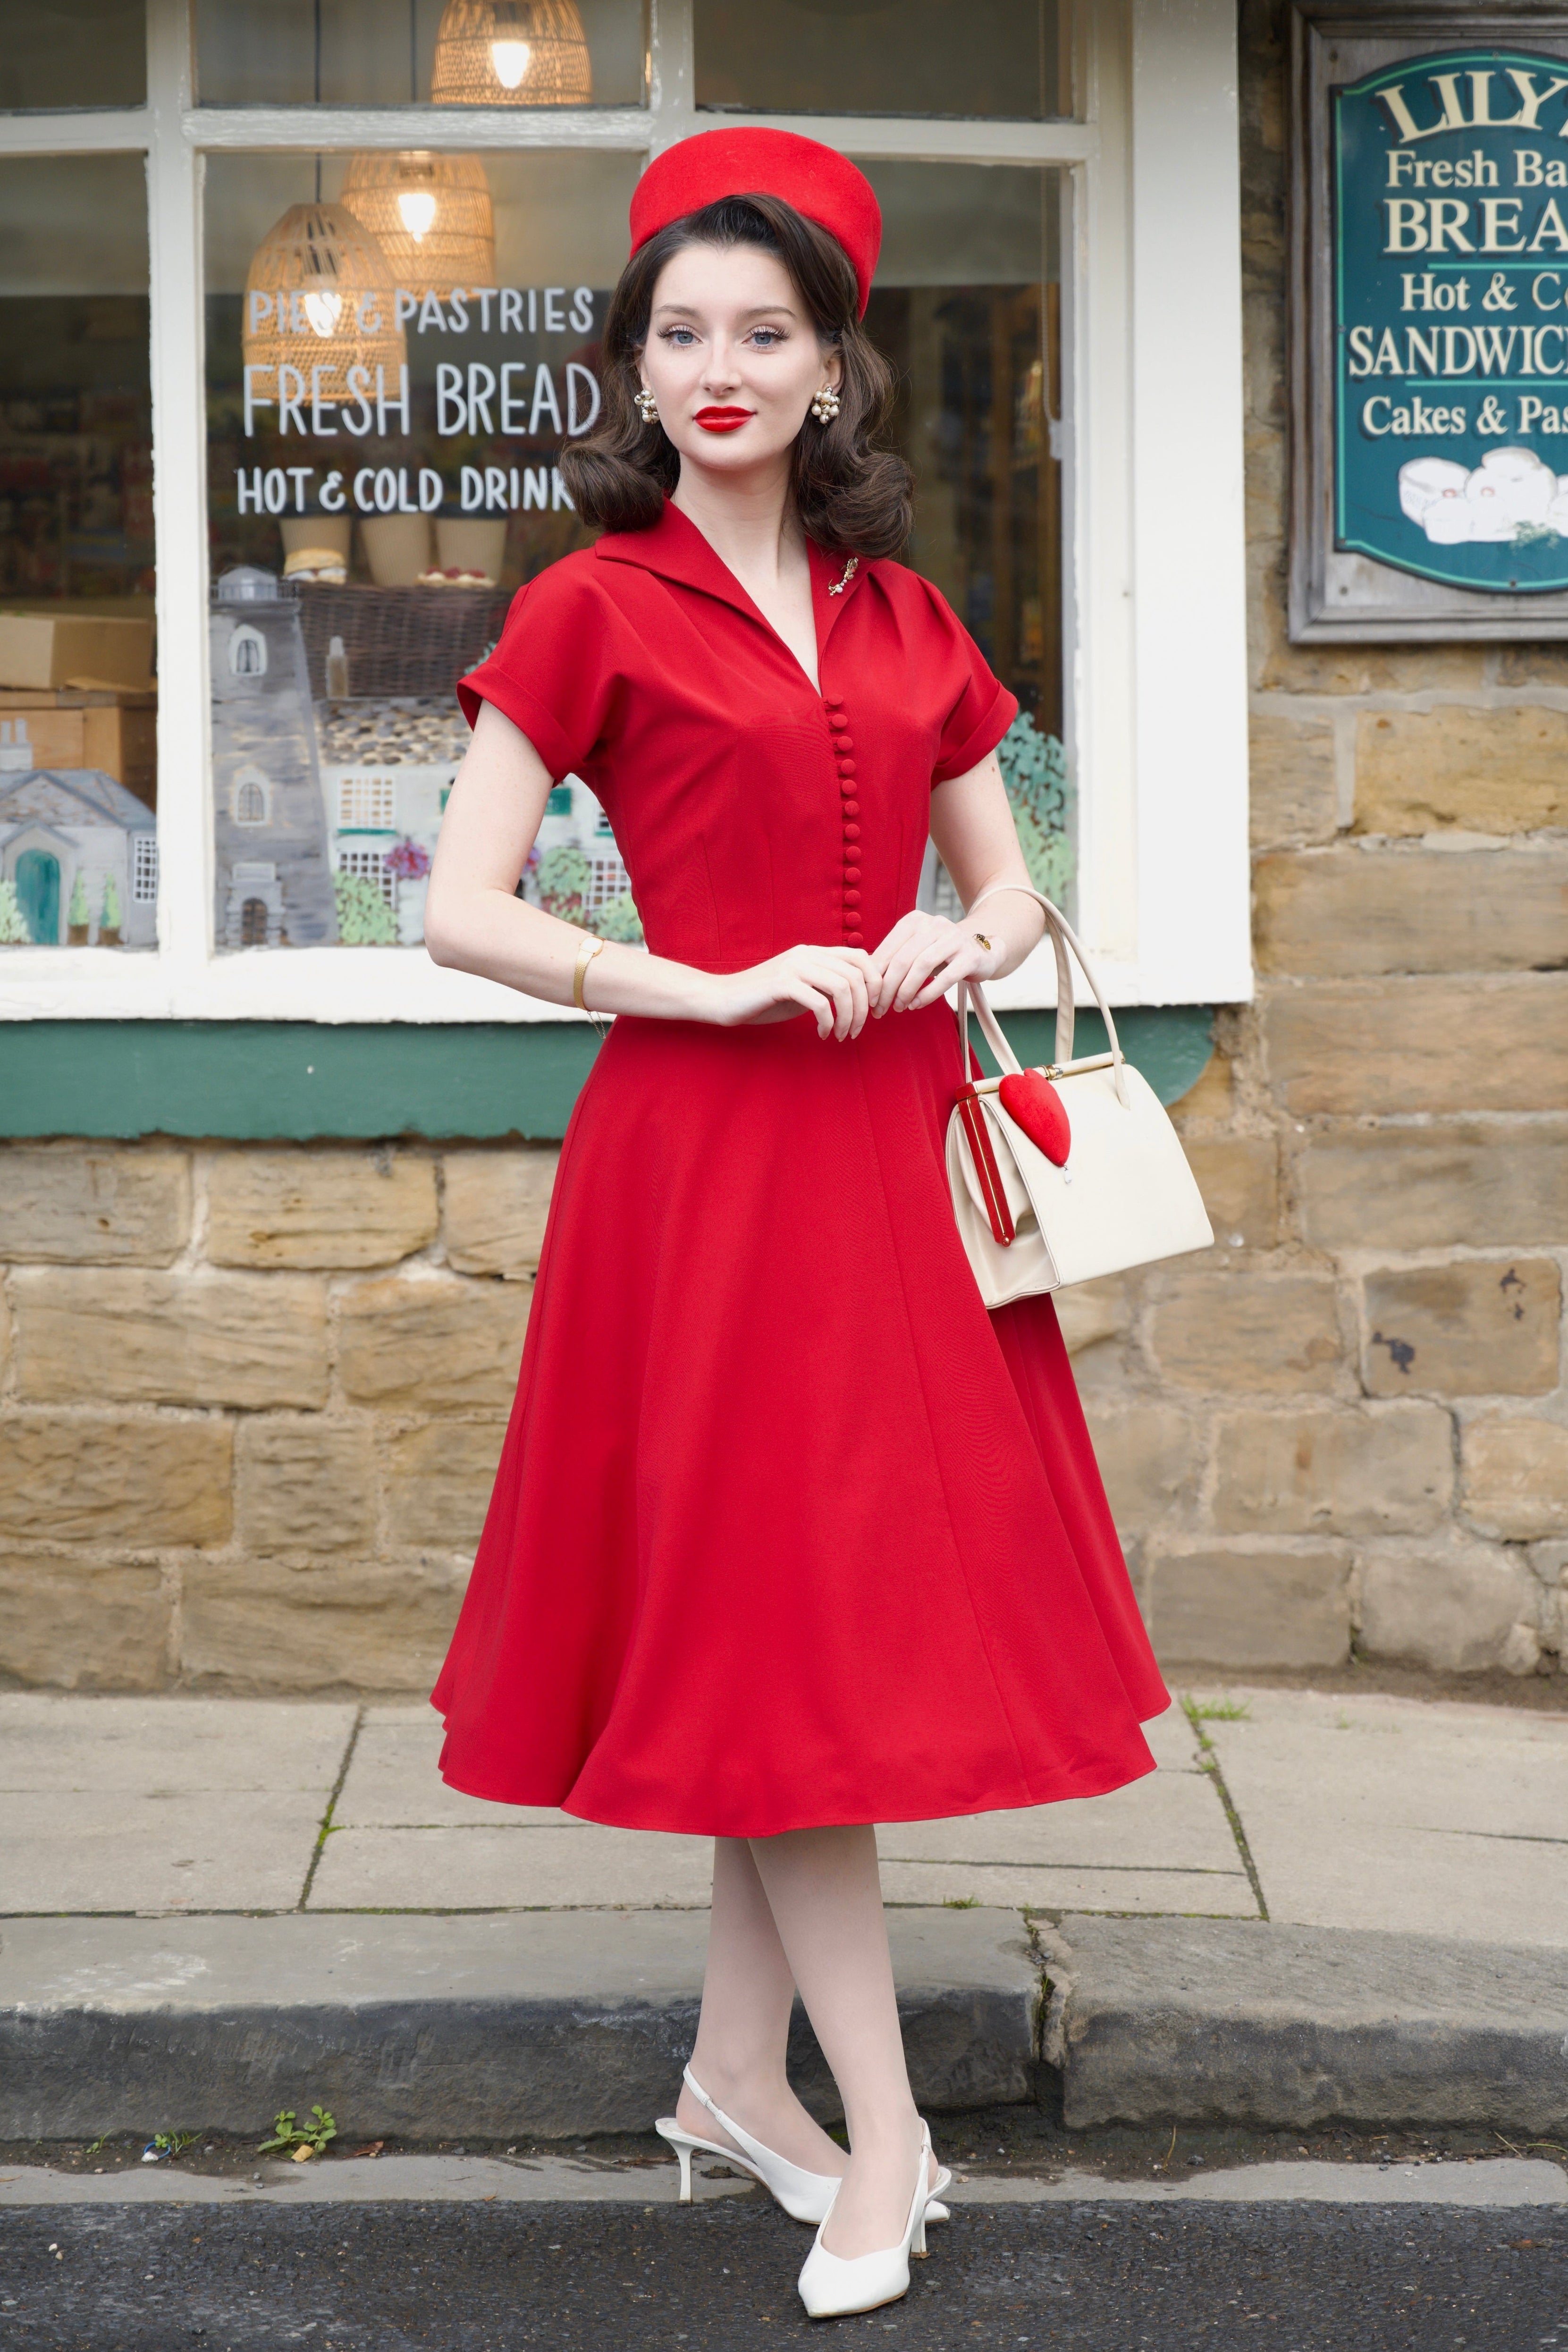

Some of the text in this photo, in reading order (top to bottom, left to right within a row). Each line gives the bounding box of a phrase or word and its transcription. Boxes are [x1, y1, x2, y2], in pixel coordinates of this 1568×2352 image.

[1385, 150, 1500, 187] Fresh
[1383, 197, 1568, 252] BREA
[249, 287, 594, 334] PIES & PASTRIES
[1400, 273, 1470, 311] Hot
[1482, 272, 1518, 311] &
[1349, 325, 1568, 376] SANDWIC
[244, 362, 600, 437] FRESH BREAD
[1362, 396, 1466, 435] Cakes
[1476, 396, 1509, 435] &
[236, 467, 314, 514] HOT
[318, 470, 346, 511] &
[353, 467, 443, 513] COLD
